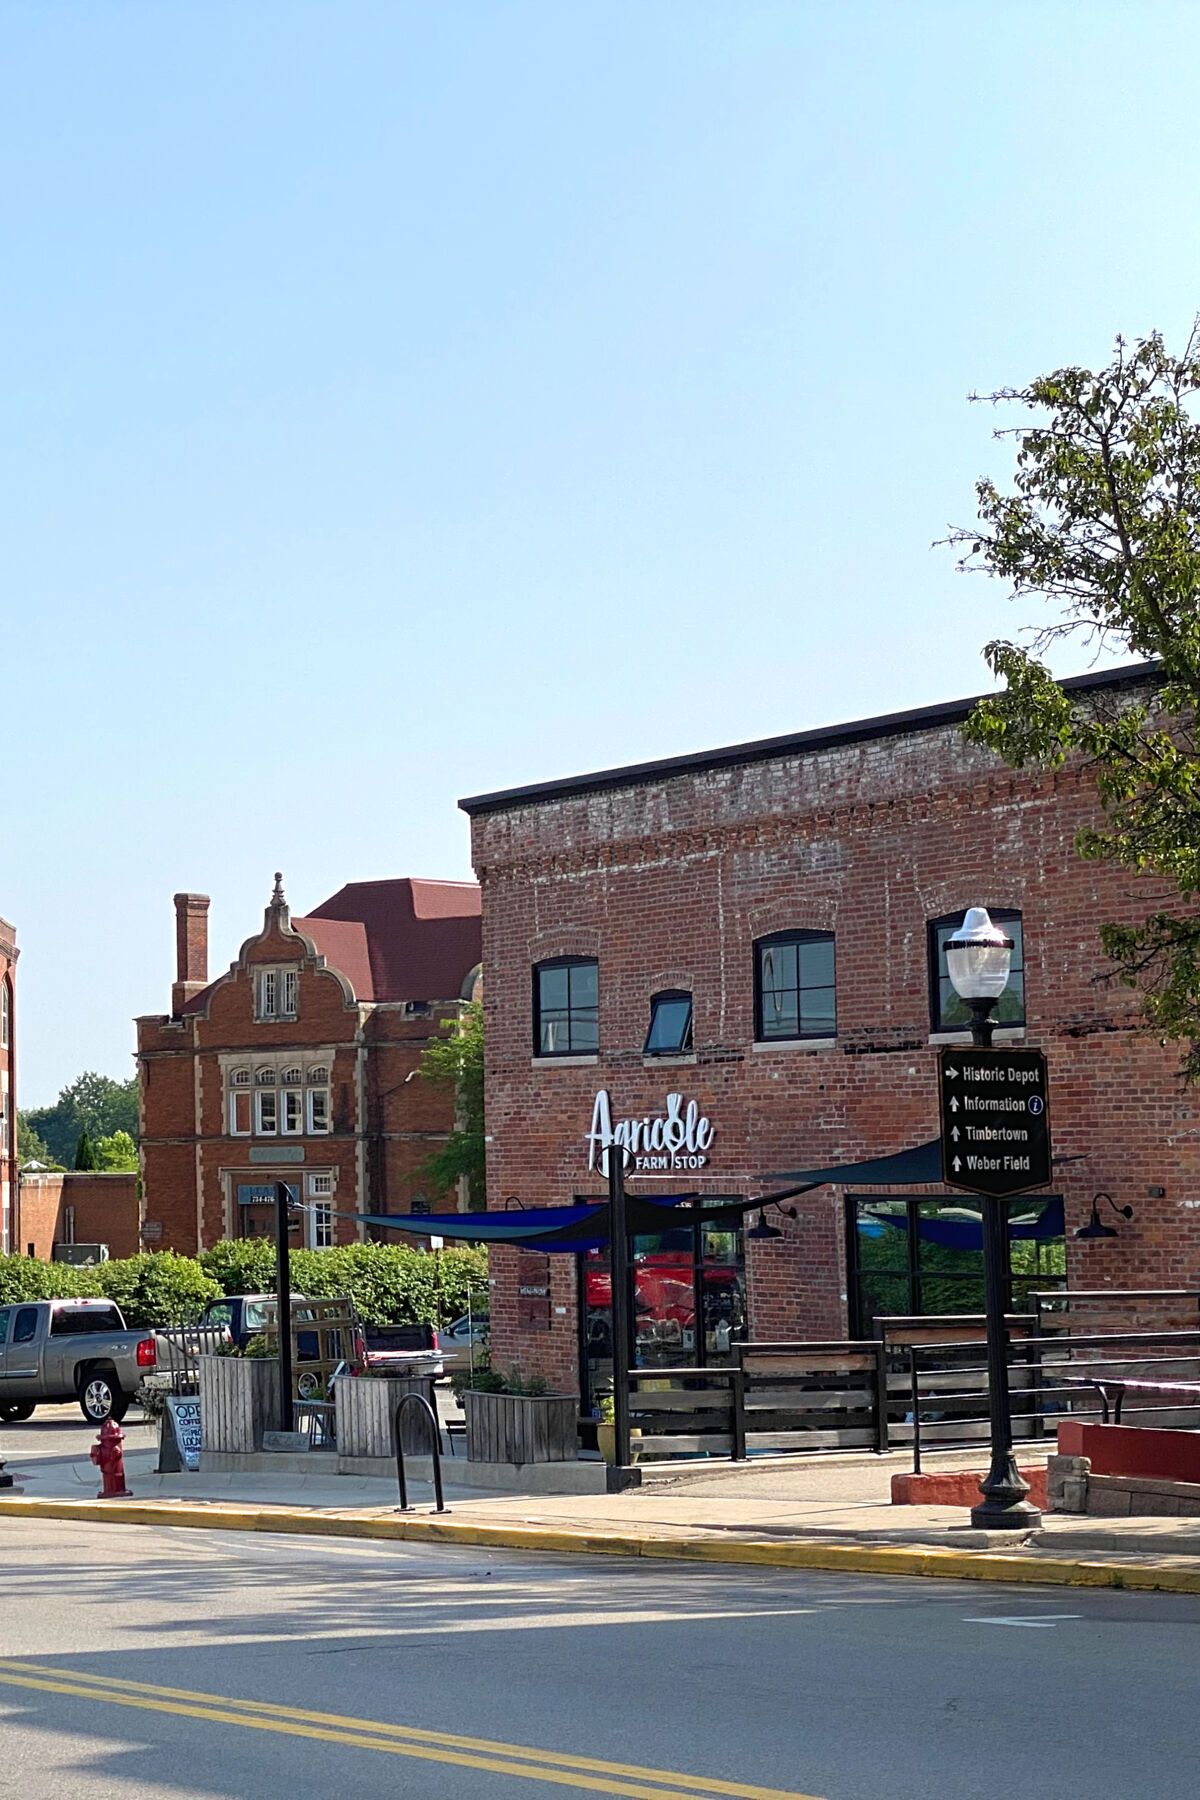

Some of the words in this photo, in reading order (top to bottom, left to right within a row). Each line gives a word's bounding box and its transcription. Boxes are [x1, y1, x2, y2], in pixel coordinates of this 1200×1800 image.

[963, 1066, 1005, 1081] Historic
[1008, 1067, 1040, 1085] Depot
[964, 1096, 1026, 1111] Information
[965, 1126, 1028, 1141] Timbertown
[636, 1157, 667, 1169] FARM
[675, 1156, 706, 1169] STOP
[966, 1156, 1001, 1170] Weber
[1003, 1156, 1030, 1170] Field
[176, 1405, 200, 1418] OPE
